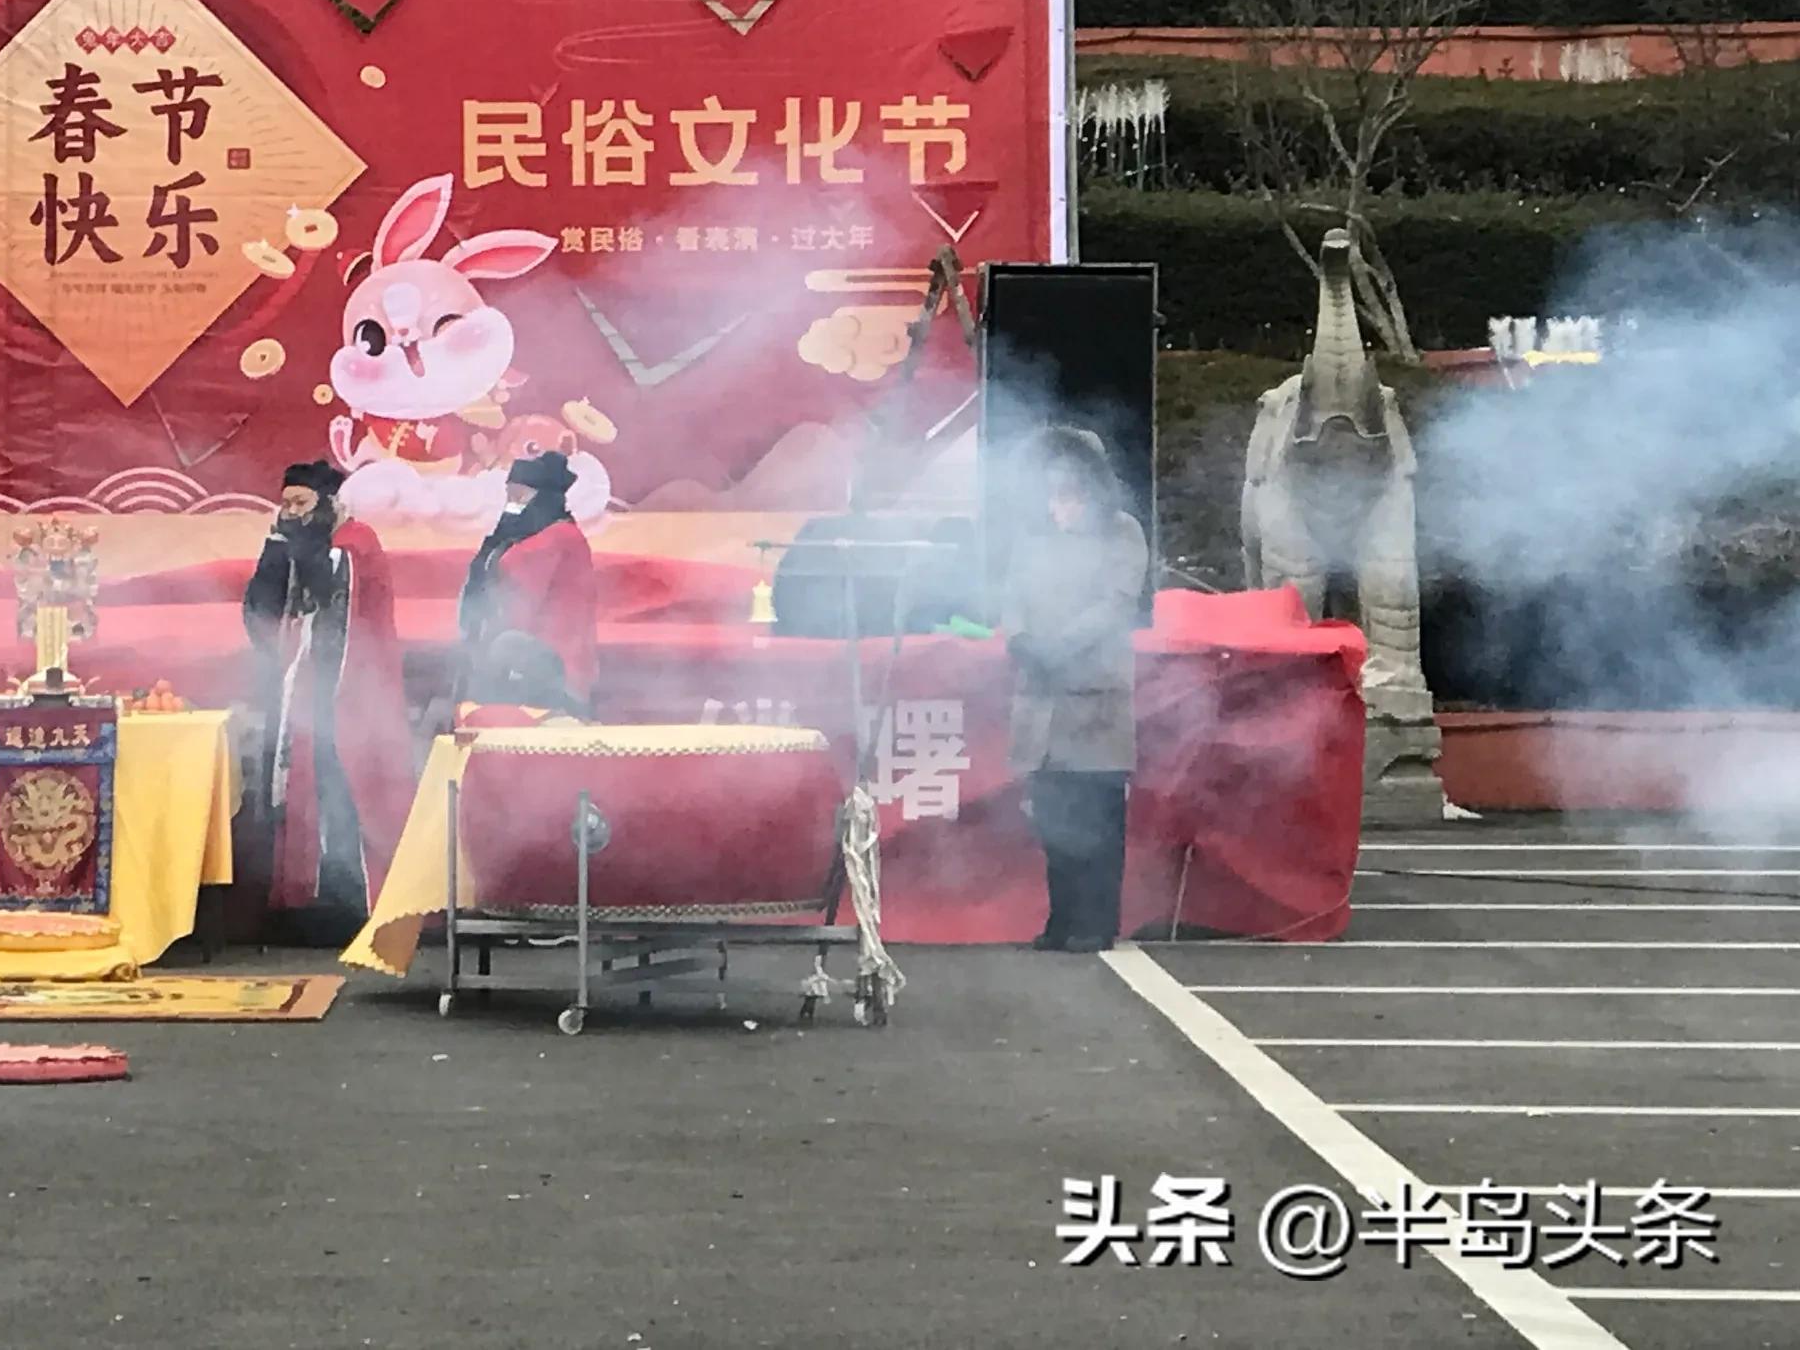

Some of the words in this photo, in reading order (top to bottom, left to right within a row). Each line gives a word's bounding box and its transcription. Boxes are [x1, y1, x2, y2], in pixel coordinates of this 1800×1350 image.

[28, 62, 224, 166] 春节
[462, 95, 971, 188] 民俗文化节
[29, 171, 220, 269] 快乐
